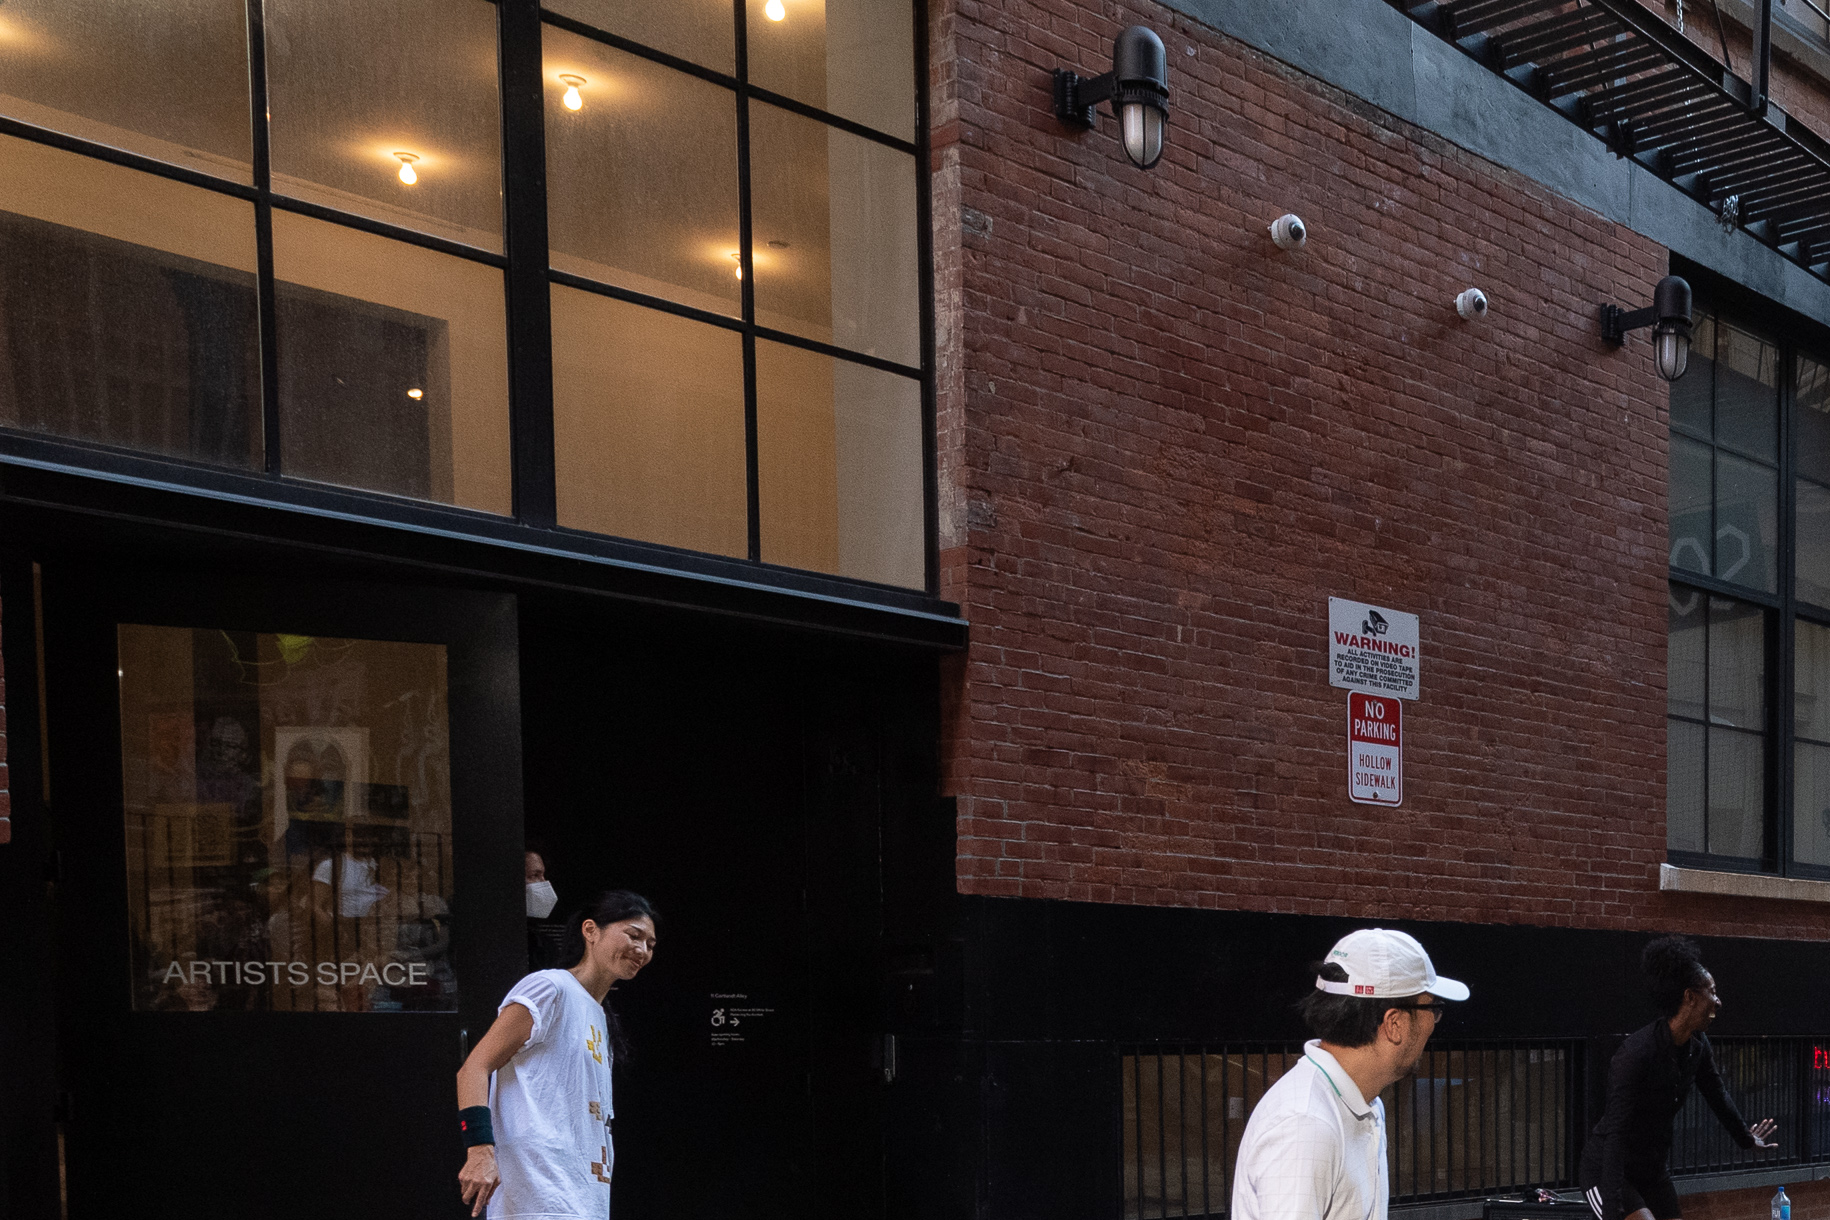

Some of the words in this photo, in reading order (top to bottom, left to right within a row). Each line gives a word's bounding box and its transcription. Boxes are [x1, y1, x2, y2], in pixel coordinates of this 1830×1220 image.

[1334, 631, 1416, 659] WARNING!
[1336, 653, 1369, 665] RECORDED
[1380, 661, 1397, 670] VIDEO
[1398, 665, 1413, 673] TAPE
[1347, 649, 1358, 657] ALL
[1360, 651, 1390, 662] ACTIVITIES
[1391, 657, 1403, 665] ARE
[1343, 661, 1354, 669] AID
[1363, 665, 1375, 673] THE
[1375, 668, 1415, 680] PROSECUTION
[1345, 669, 1358, 677] ANY
[1359, 671, 1378, 681] CRIME
[1379, 675, 1413, 687] COMMITTED
[1342, 676, 1368, 686] AGAINST
[1369, 679, 1382, 688] THIS
[1383, 682, 1408, 692] FACILITY
[1365, 700, 1385, 719] NO
[1354, 718, 1396, 741] PARKING
[1359, 753, 1392, 771] HOLLOW
[1355, 771, 1396, 790] SIDEWALK
[162, 960, 310, 985] ARTISTS
[316, 961, 428, 986] SPACE
